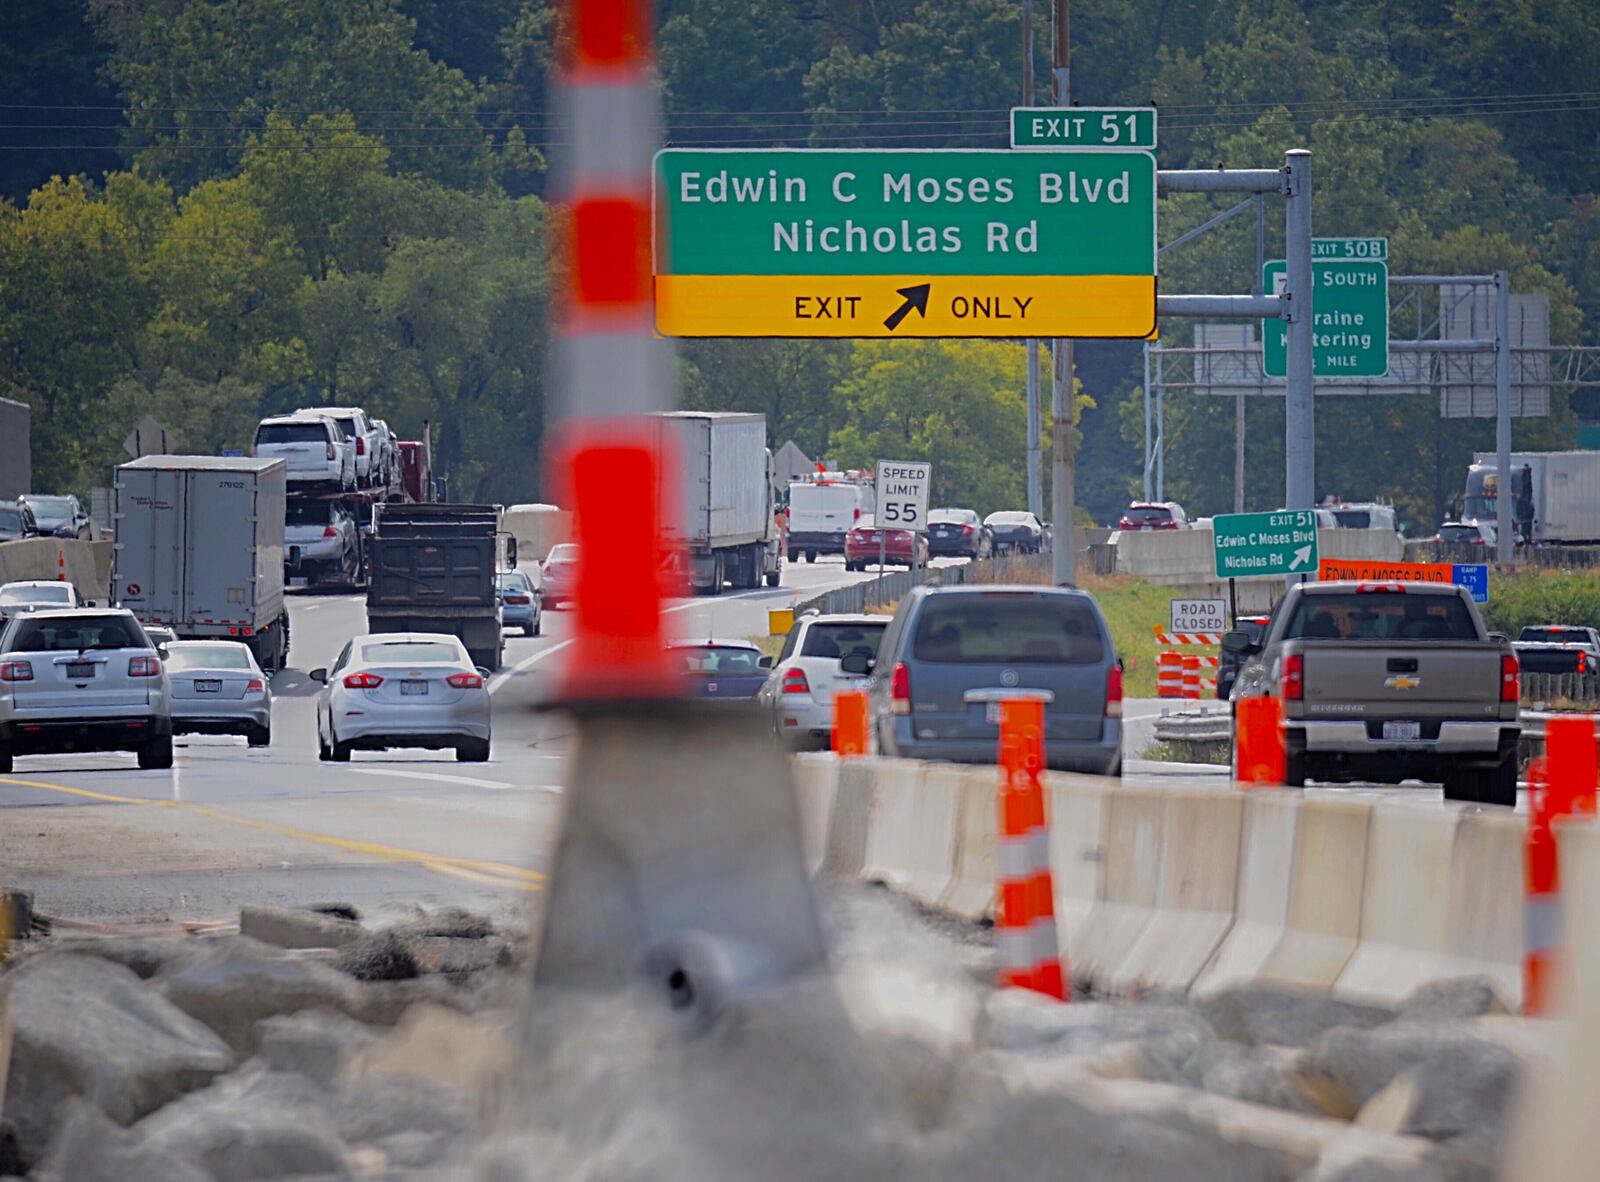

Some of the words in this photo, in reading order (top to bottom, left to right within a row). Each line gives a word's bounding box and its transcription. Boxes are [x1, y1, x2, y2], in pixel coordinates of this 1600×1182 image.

[1032, 118, 1085, 138] EXIT
[1101, 113, 1138, 143] 51
[680, 169, 807, 204] Edwin
[832, 171, 857, 203] C
[883, 172, 1015, 204] Moses
[1039, 169, 1131, 205] Blvd
[773, 219, 962, 254] Nicholas
[987, 219, 1039, 254] Rd
[1345, 241, 1381, 257] 50B
[1323, 271, 1377, 287] SOUTH
[796, 296, 862, 319] EXIT
[951, 296, 1034, 319] ONLY
[1314, 310, 1365, 326] raine
[1280, 332, 1372, 349] Ktering
[1327, 355, 1358, 367] MILE
[883, 467, 925, 480] SPEED
[886, 484, 919, 496] LIMIT
[885, 502, 917, 523] 55
[1270, 515, 1293, 527] EXIT
[1297, 512, 1313, 526] 51
[1216, 533, 1246, 548] Edwin
[1250, 533, 1257, 545] C
[1259, 531, 1291, 545] Moses
[1293, 530, 1315, 543] Blvd
[1225, 555, 1268, 569] Nicholas
[1270, 554, 1284, 567] Rd
[1181, 604, 1216, 615] ROAD
[1174, 618, 1222, 629] CLOSED
